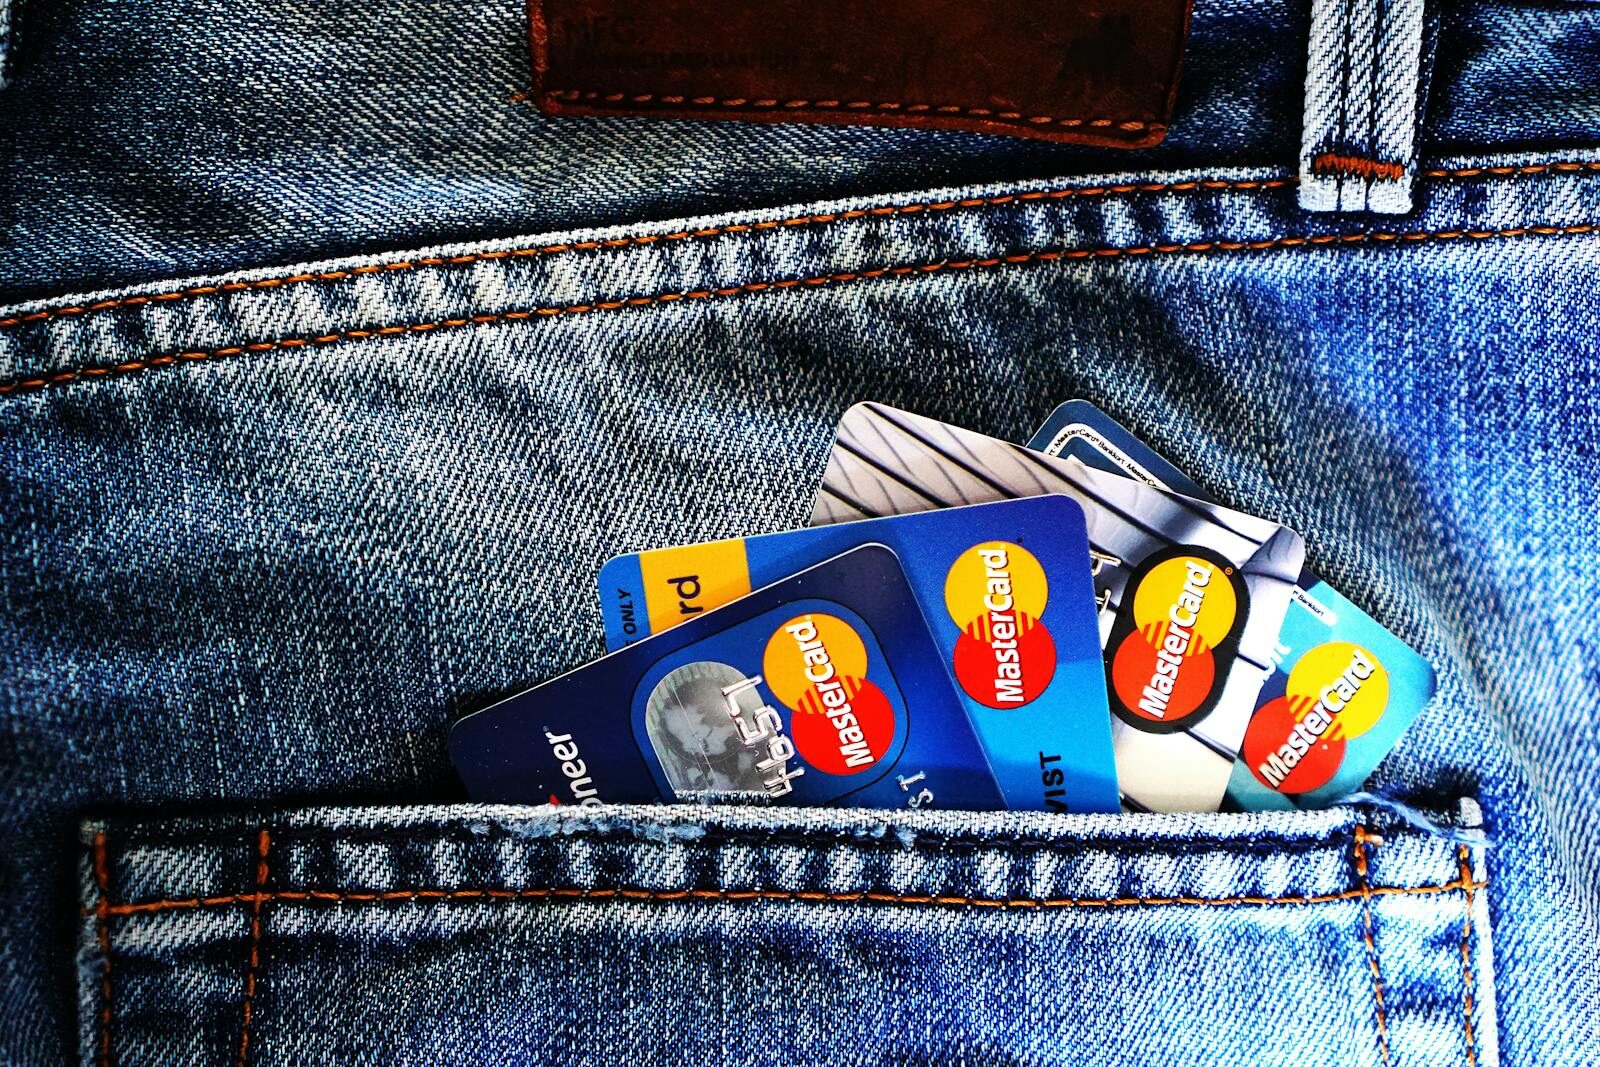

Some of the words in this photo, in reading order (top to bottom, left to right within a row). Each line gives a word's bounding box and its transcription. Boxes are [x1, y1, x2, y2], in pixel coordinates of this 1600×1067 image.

[616, 587, 637, 636] ONLY
[977, 548, 1025, 702] MasterCard
[1137, 560, 1213, 719] MasterCard
[785, 620, 875, 768] MasterCard
[1258, 649, 1376, 788] MasterCard
